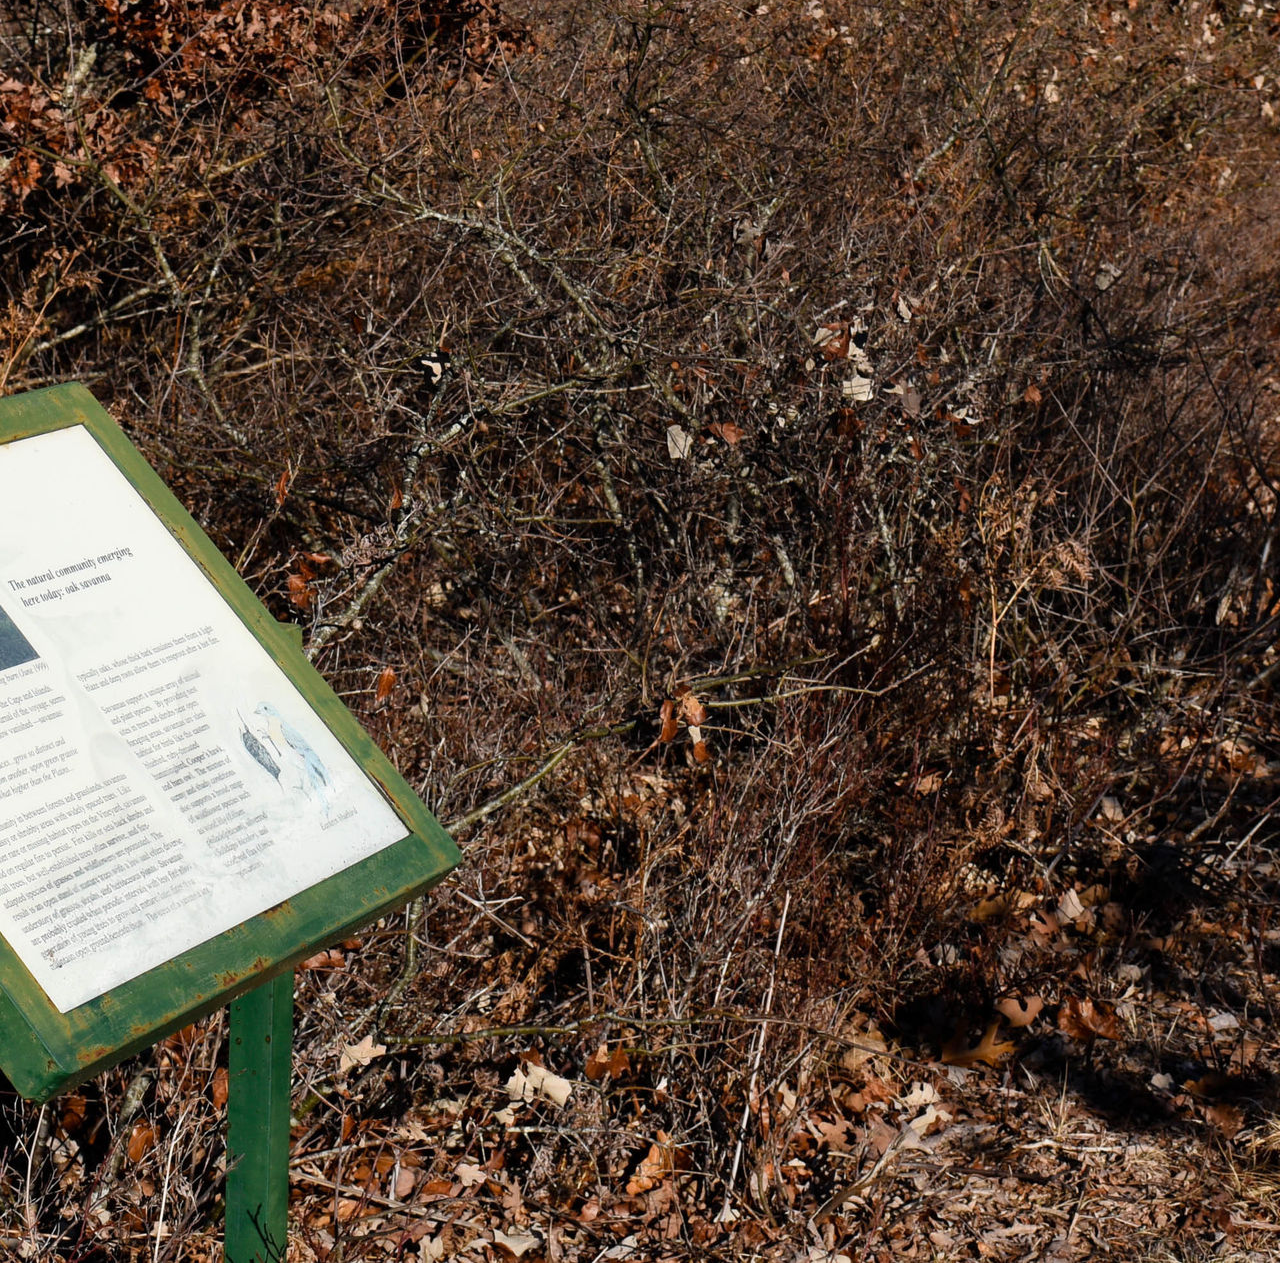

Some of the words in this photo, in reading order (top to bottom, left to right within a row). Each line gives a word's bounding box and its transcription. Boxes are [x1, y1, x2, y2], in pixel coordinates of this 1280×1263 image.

[8, 580, 25, 591] The
[26, 570, 55, 586] natural
[56, 559, 96, 577] community
[97, 548, 133, 564] emerging
[21, 597, 40, 607] here
[40, 590, 64, 601] today:
[65, 582, 80, 594] oak
[80, 574, 111, 589] savanna
[8, 697, 23, 705] Cape
[23, 691, 34, 700] and
[49, 696, 65, 705] seems
[9, 720, 33, 733] vanished
[17, 825, 40, 838] shrubby
[40, 821, 54, 829] areas
[54, 813, 68, 822] with
[67, 805, 86, 816] widely
[86, 797, 104, 810] spaced
[117, 786, 131, 795] Like
[22, 807, 47, 820] between
[45, 800, 65, 810] forests
[65, 793, 76, 803] and
[103, 775, 127, 786] savannas
[15, 859, 35, 871] regular
[34, 855, 46, 863] fire
[52, 843, 72, 857] persist.
[71, 838, 85, 846] Fire
[83, 831, 97, 841] kills
[112, 819, 128, 827] back
[127, 811, 144, 822] shrubs
[144, 805, 155, 815] and
